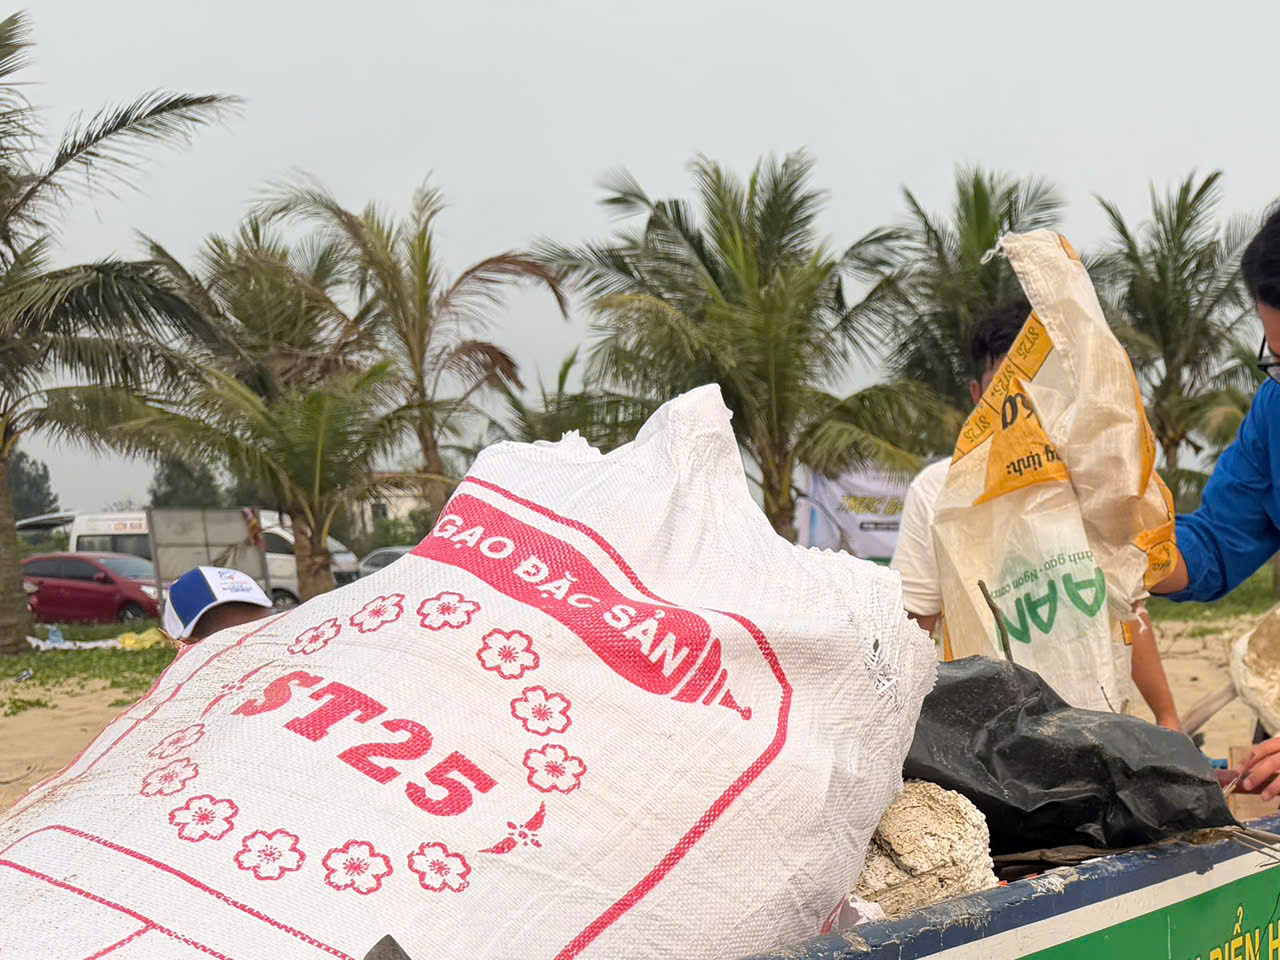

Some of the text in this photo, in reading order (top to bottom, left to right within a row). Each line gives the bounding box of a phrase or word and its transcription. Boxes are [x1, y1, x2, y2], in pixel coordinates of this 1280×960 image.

[432, 514, 691, 678] GẠO ĐẶC SẢN
[1062, 567, 1106, 618] A
[231, 670, 499, 816] ST25
